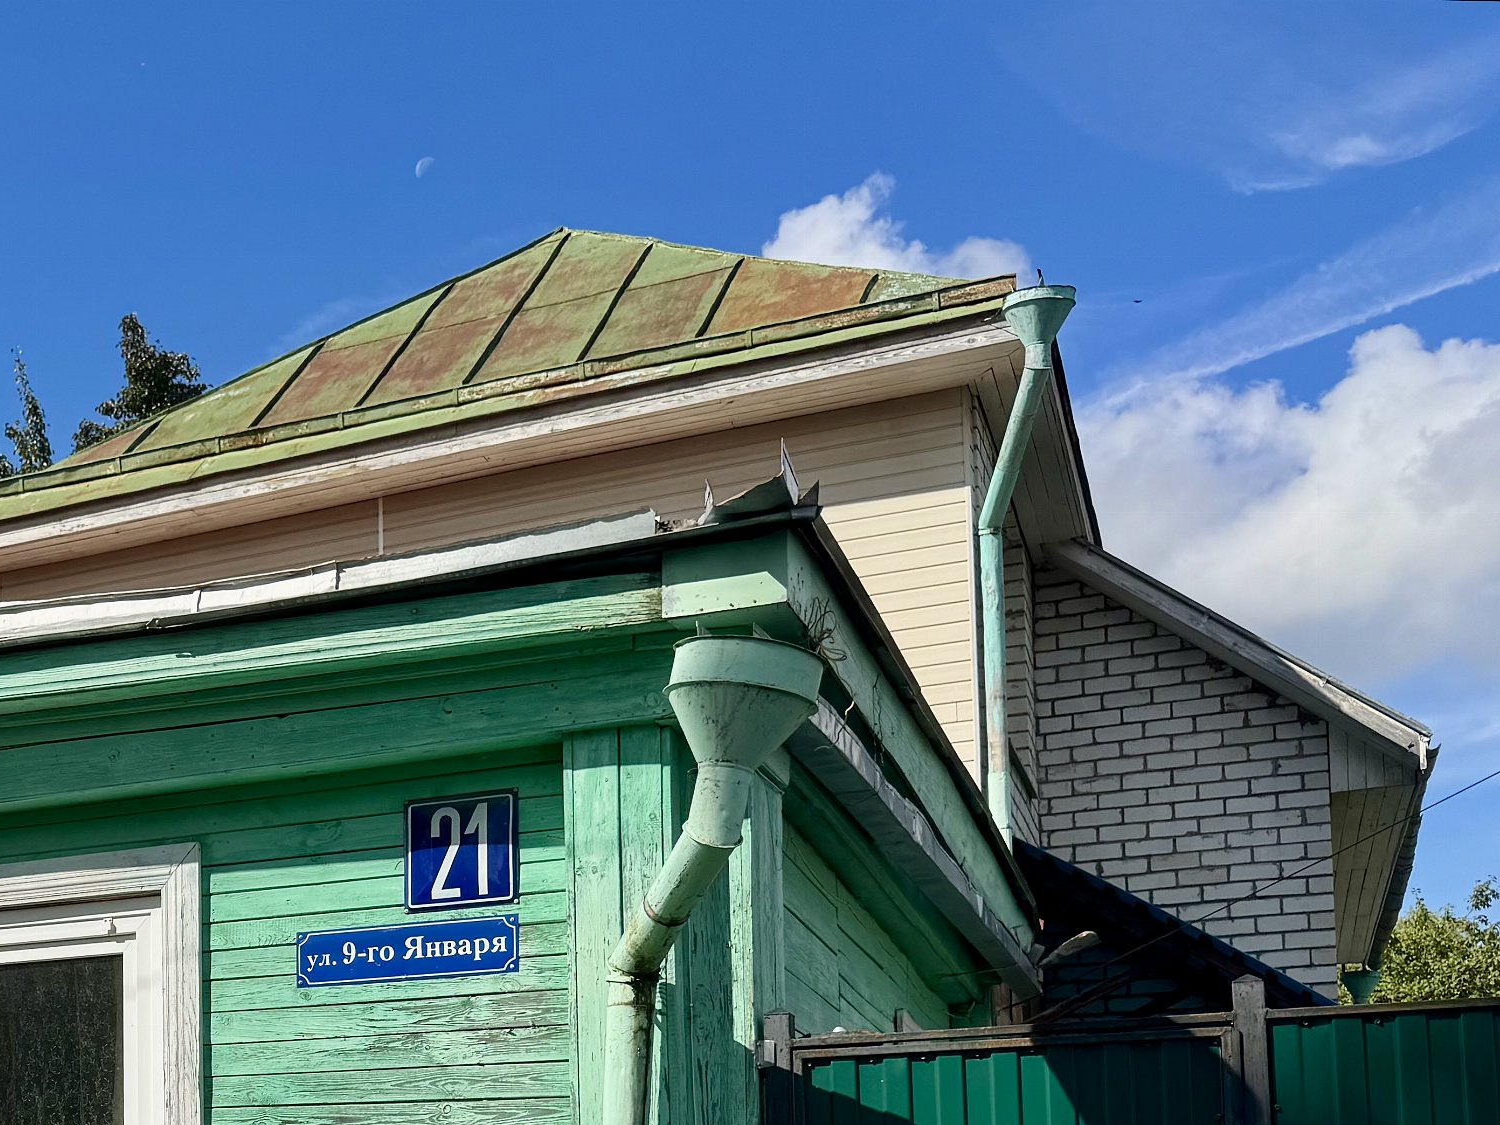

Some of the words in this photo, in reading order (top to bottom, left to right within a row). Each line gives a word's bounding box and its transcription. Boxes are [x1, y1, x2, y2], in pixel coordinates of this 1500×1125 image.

[430, 802, 489, 900] 21
[306, 953, 337, 972] ул.
[342, 941, 395, 965] 9-го
[402, 935, 508, 961] Января
